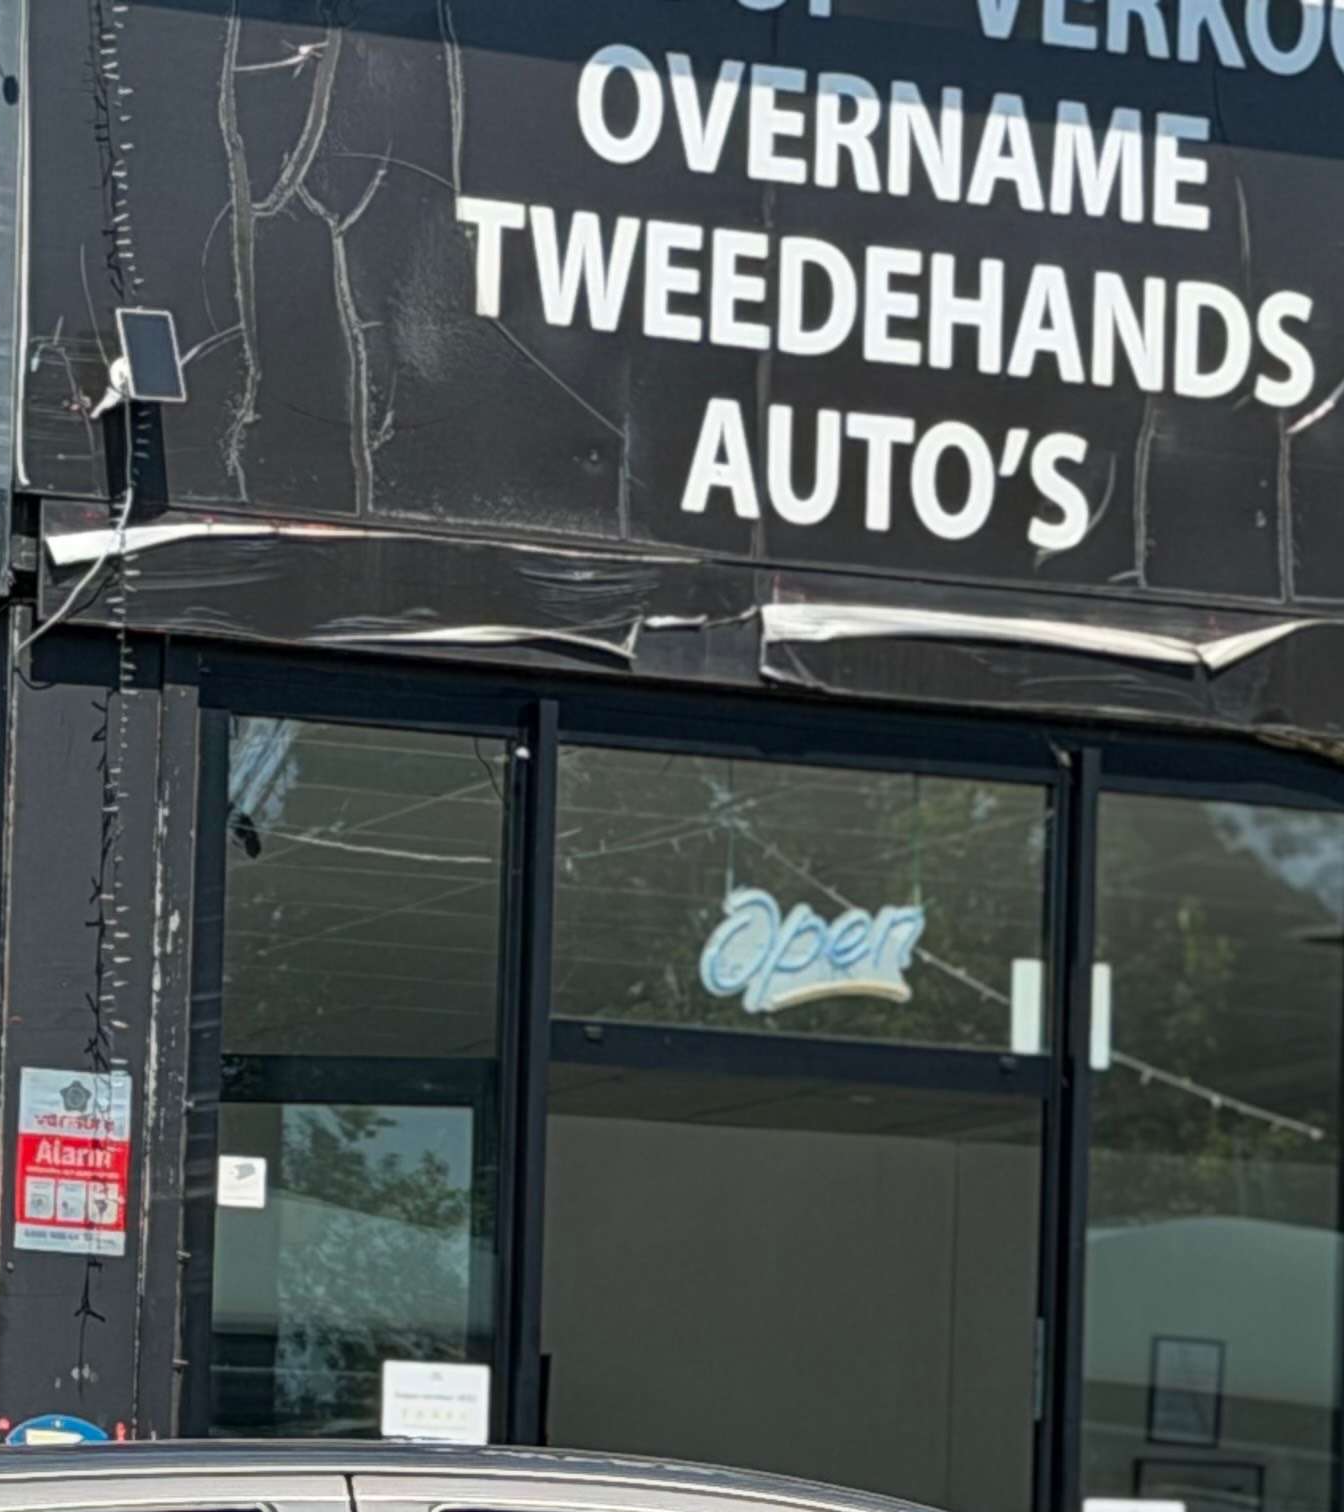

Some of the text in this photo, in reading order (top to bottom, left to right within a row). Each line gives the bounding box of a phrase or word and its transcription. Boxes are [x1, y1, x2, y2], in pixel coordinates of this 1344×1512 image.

[577, 43, 1211, 231] OVERNAME
[456, 196, 1315, 408] TWEEDEHANDS
[700, 888, 925, 1012] Open
